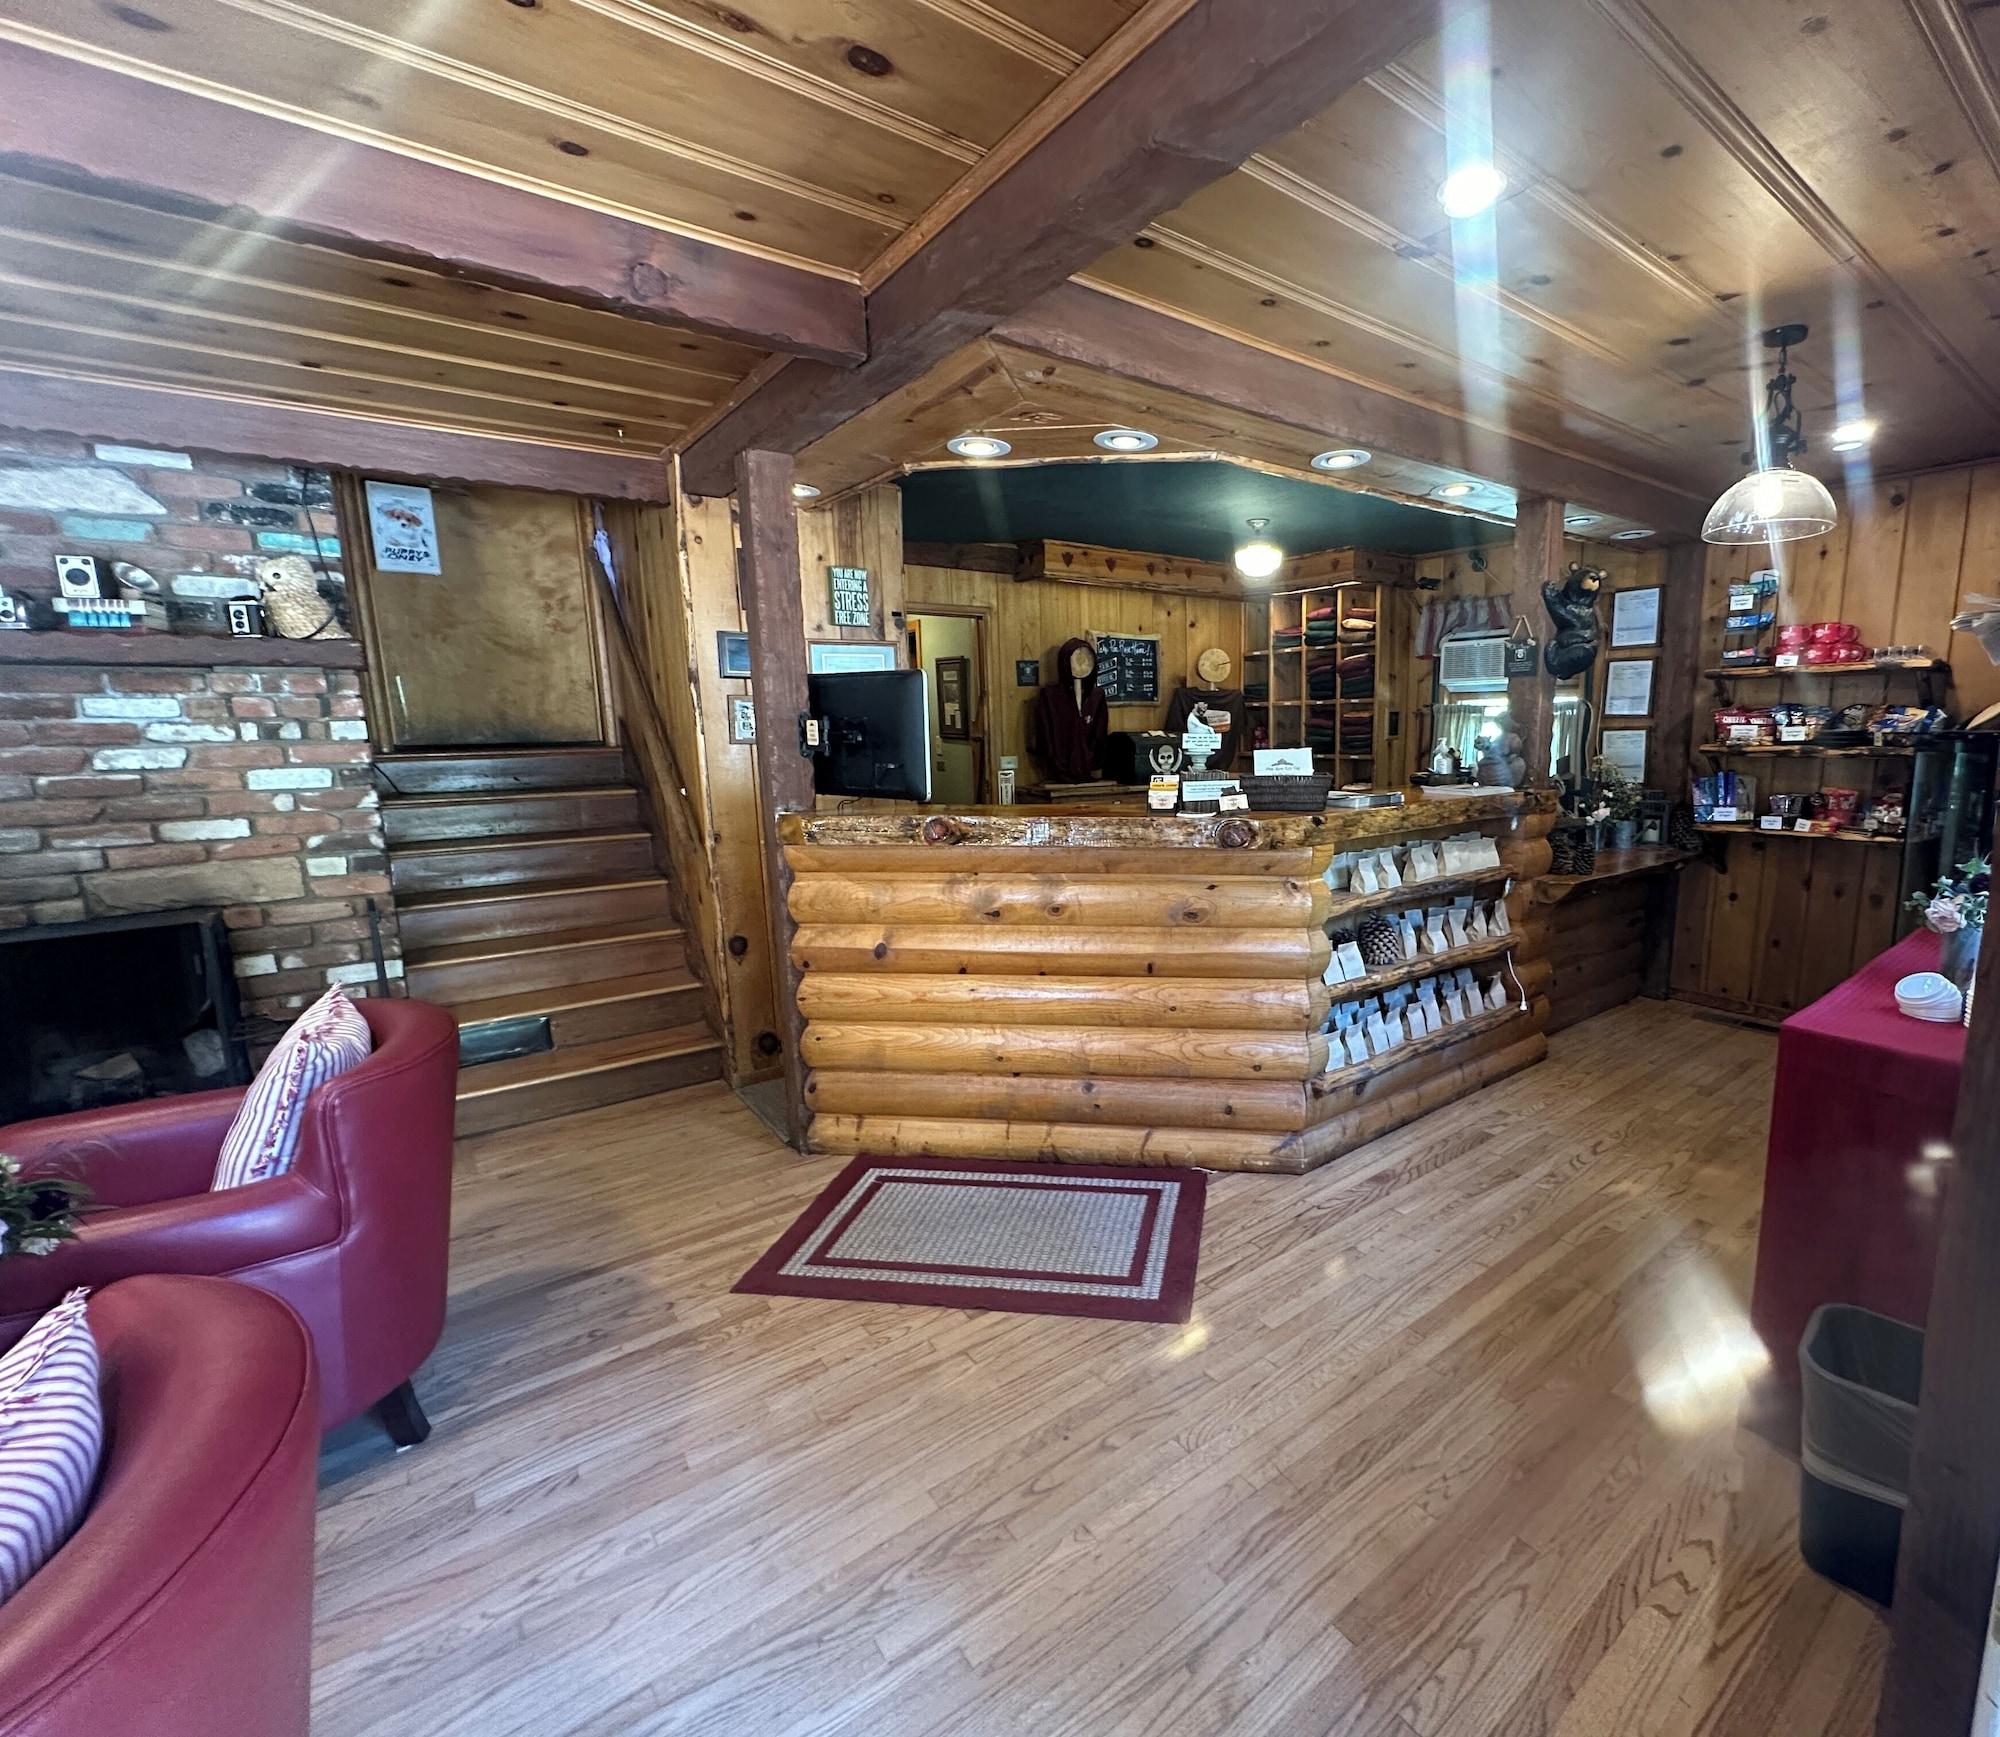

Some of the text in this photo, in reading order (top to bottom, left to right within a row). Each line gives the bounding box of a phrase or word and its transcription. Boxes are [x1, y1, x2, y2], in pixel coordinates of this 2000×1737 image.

[832, 566, 867, 580] YOU ARE NOW
[834, 578, 868, 592] ENTERING A
[834, 590, 869, 612] STRESS
[835, 610, 870, 626] FREE ZONE
